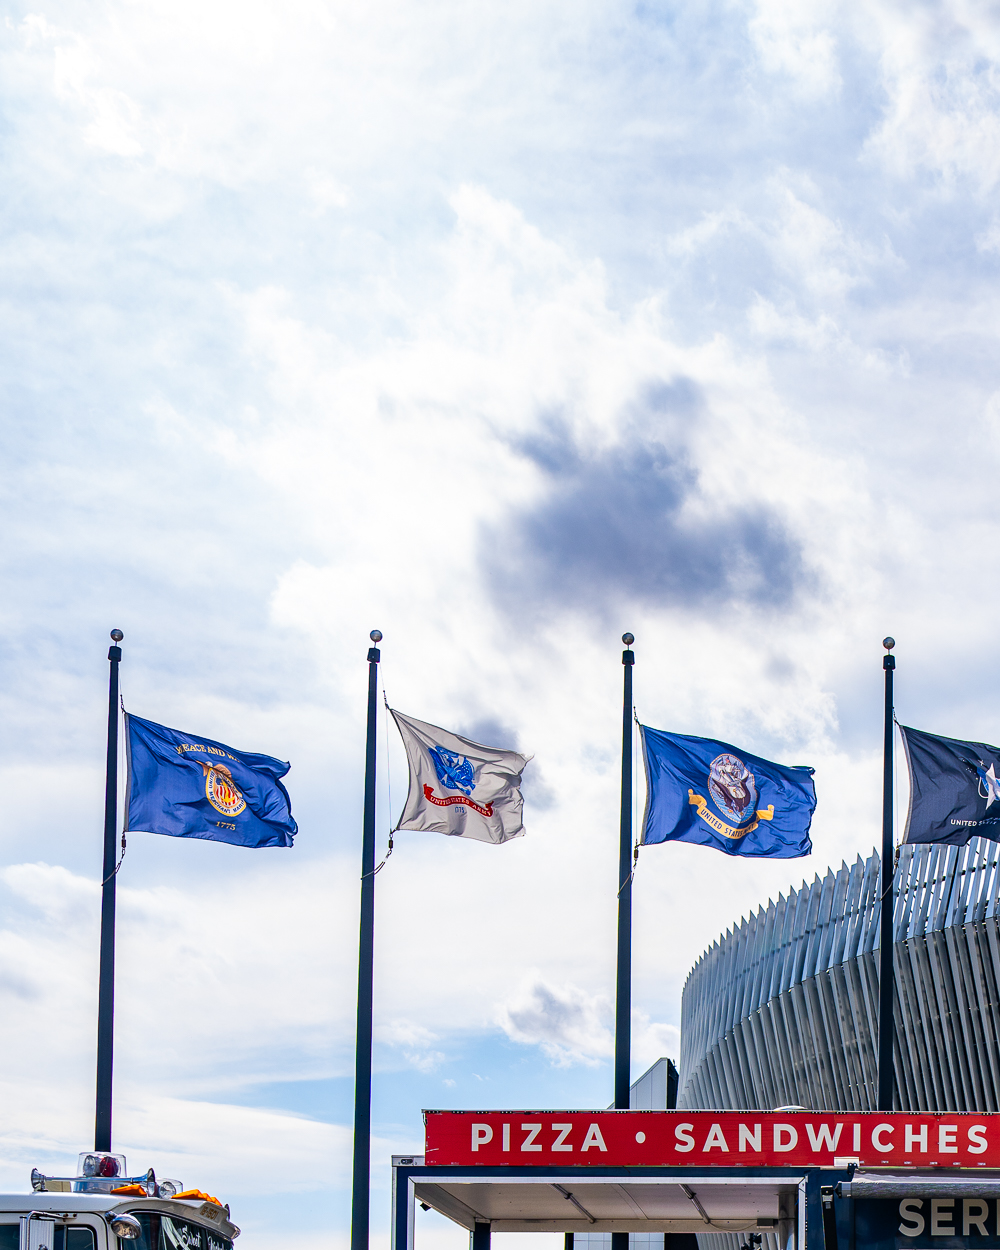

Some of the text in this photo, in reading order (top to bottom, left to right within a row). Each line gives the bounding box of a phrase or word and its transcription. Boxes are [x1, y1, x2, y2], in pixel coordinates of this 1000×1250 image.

[207, 746, 225, 757] AND
[472, 804, 491, 816] ARMY
[700, 808, 723, 831] UNITED
[950, 818, 978, 827] UNITED
[216, 820, 236, 831] 1775
[471, 1123, 607, 1152] PIZZA
[674, 1123, 989, 1154] SANDWICHES
